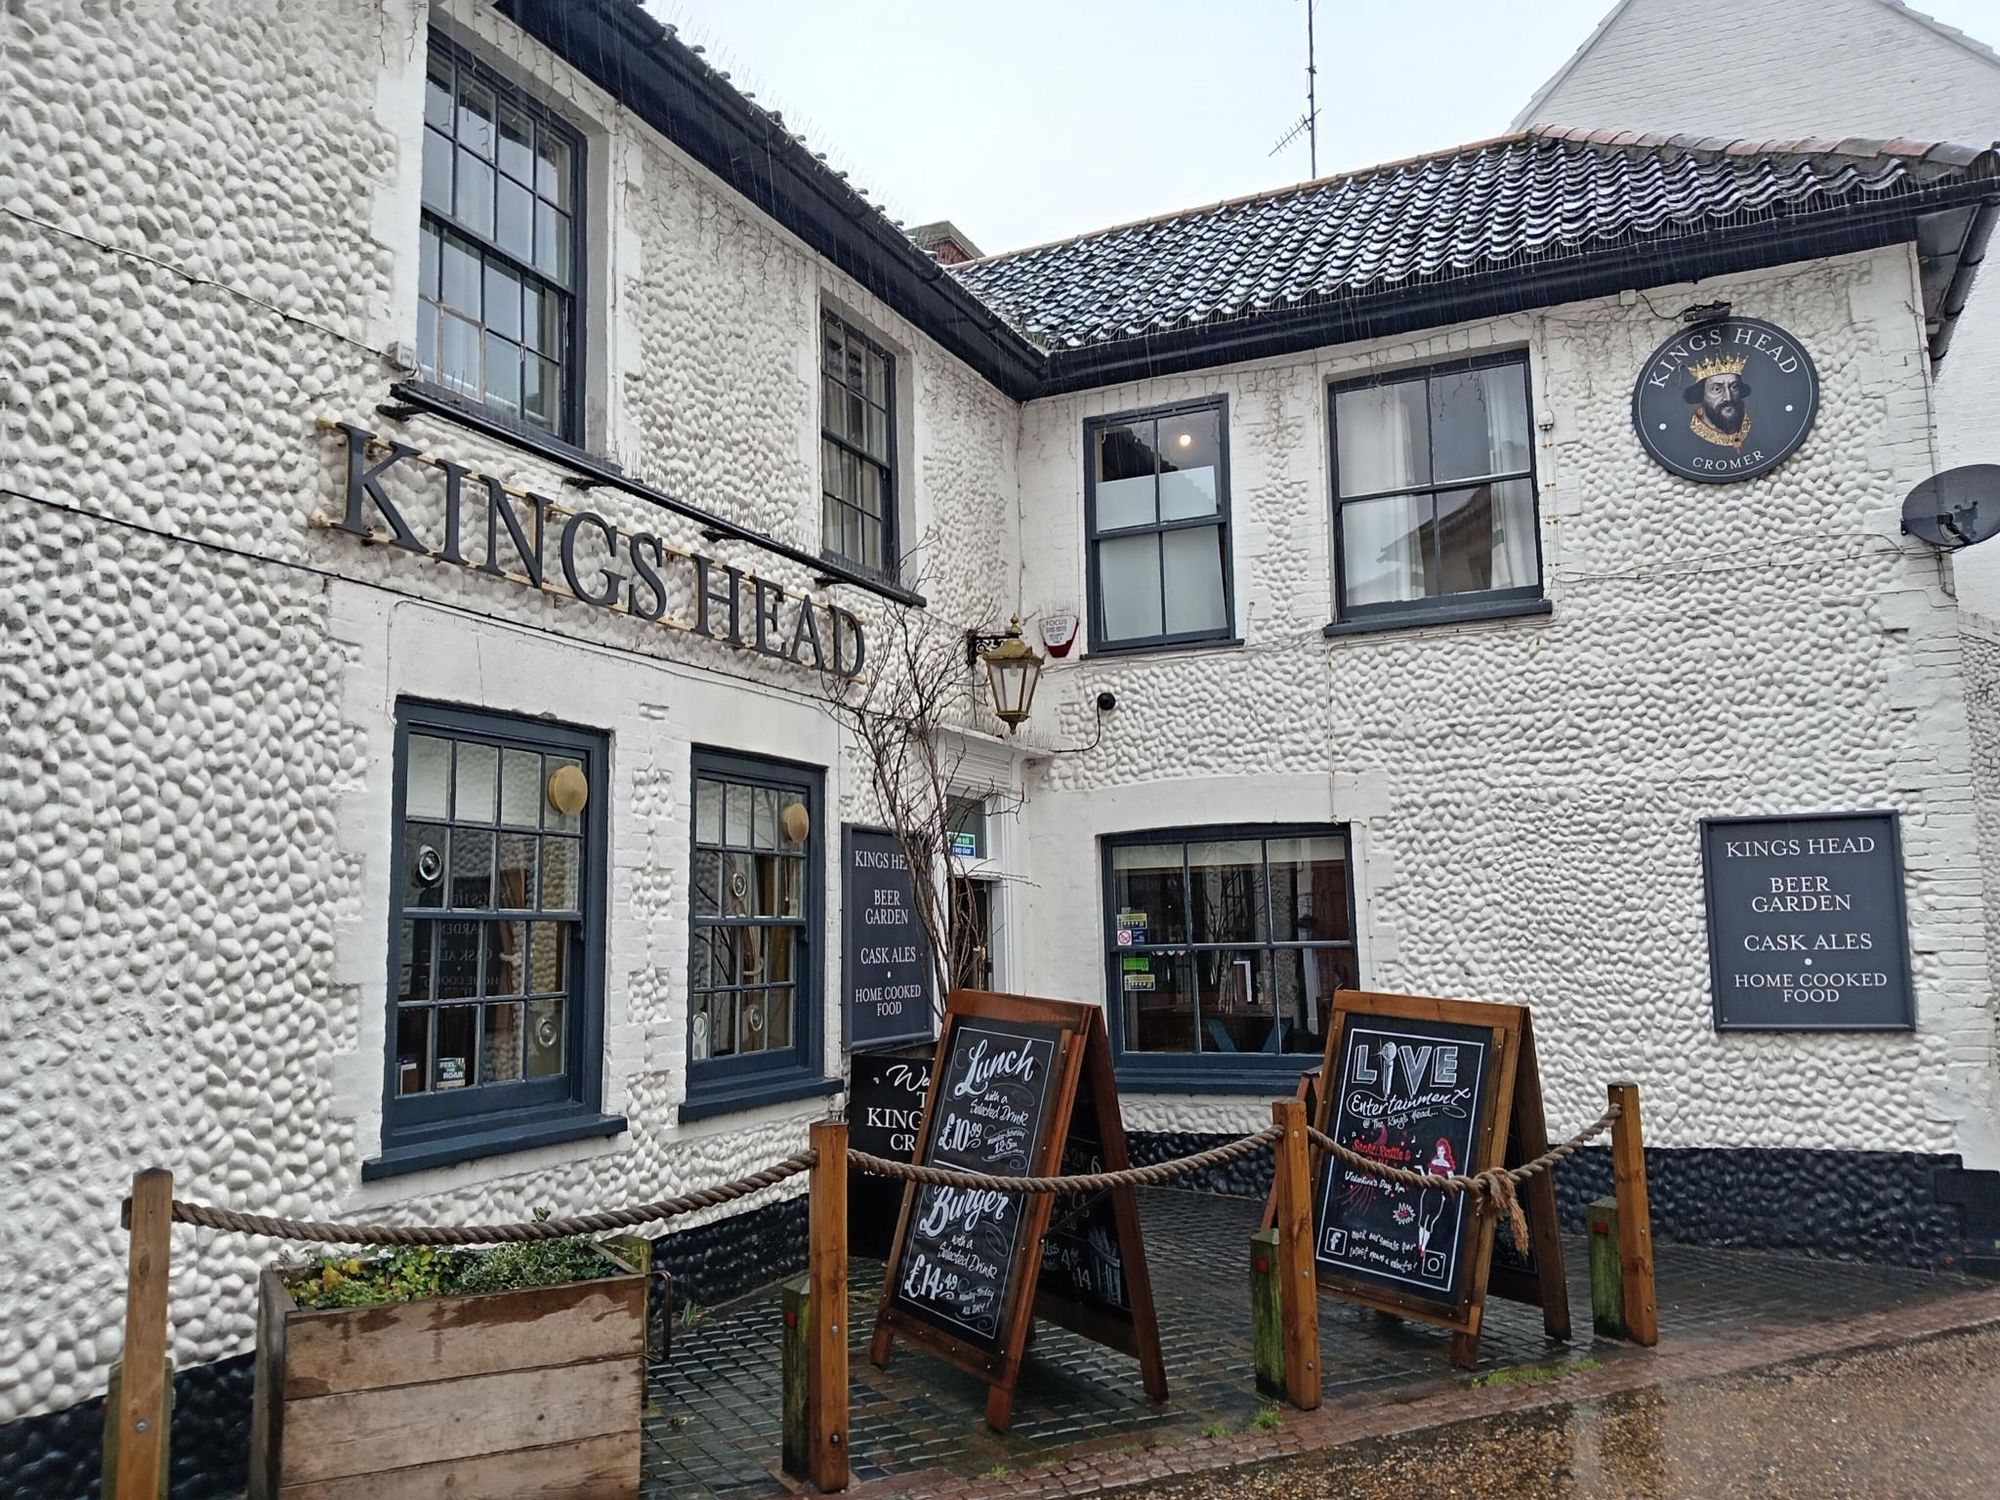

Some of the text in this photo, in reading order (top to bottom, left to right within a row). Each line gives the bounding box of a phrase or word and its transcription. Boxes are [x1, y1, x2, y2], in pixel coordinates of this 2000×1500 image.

[1649, 328, 1798, 388] KINGS HEAD
[1692, 450, 1764, 470] CROMER
[331, 421, 866, 678] KINGS HEAD
[1726, 837, 1875, 857] KINGS HEAD
[855, 851, 908, 870] KINGS HE
[1769, 876, 1830, 893] BEER
[874, 890, 900, 905] BEER
[1752, 895, 1851, 912] GARDEN
[865, 909, 908, 924] GARDEN
[1744, 933, 1873, 951] CASK ALES
[861, 947, 916, 964] CASK ALES
[1735, 972, 1887, 987] HOME COOKED
[855, 984, 921, 1002] HOME COOKED
[1784, 989, 1839, 1003] FOOD
[877, 1001, 902, 1016] FOOD
[955, 1039, 1034, 1096] Lunch
[1352, 1042, 1459, 1099] LIVE
[1351, 1088, 1471, 1117] Entertainment
[866, 1107, 924, 1130] KING
[919, 1184, 1009, 1237] Burger
[938, 1241, 998, 1279] Selected Drink
